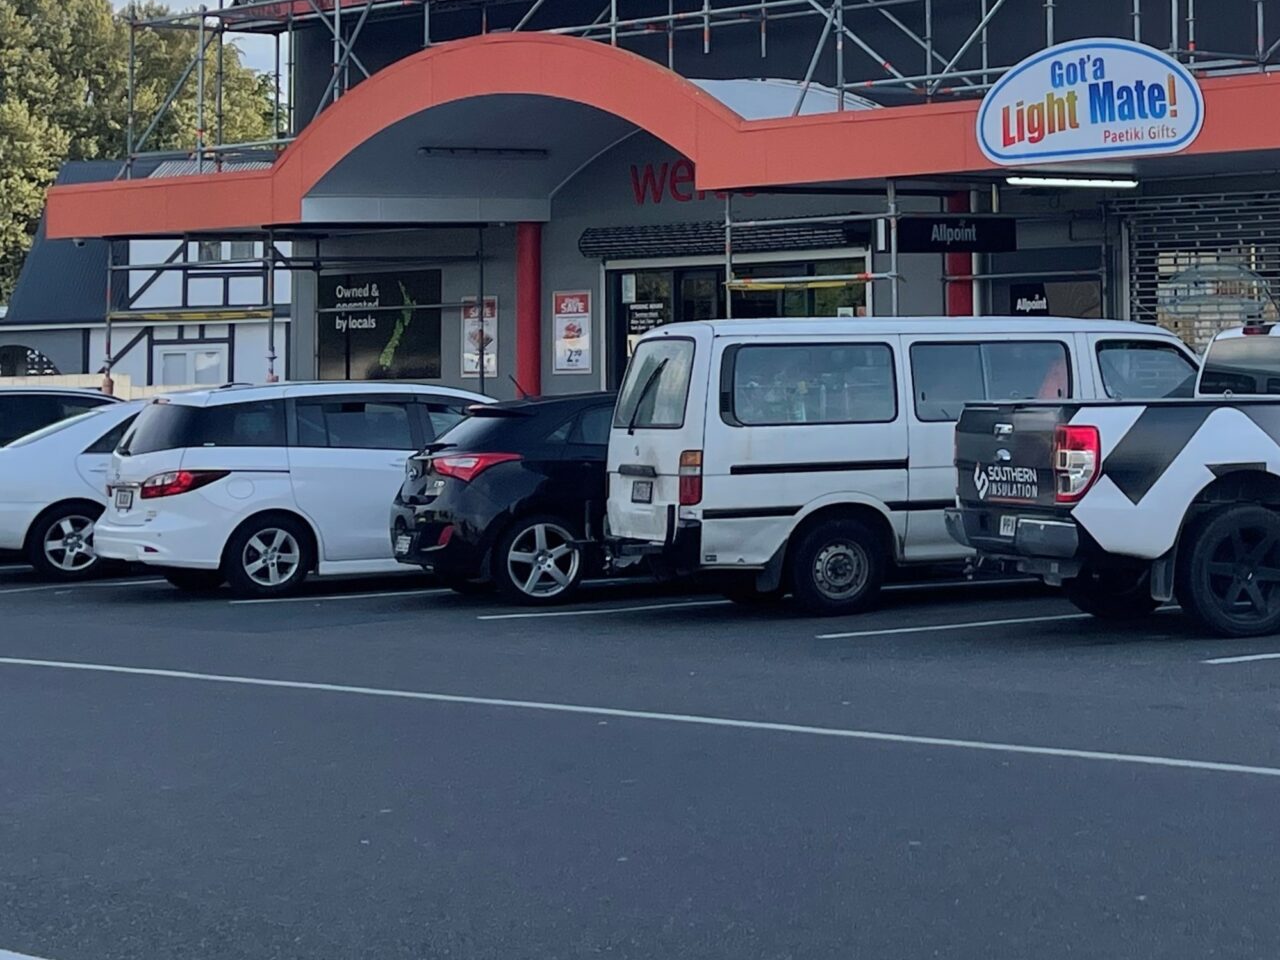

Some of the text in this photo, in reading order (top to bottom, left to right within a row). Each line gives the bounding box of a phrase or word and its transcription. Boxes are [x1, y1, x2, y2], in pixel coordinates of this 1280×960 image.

[1051, 54, 1105, 89] Got'a
[1002, 72, 1178, 148] Light Mate!
[1103, 124, 1177, 144] Paetiki Gifts
[931, 222, 976, 245] Allpoint
[335, 283, 380, 298] Owned &
[560, 301, 585, 314] SAVE
[1016, 296, 1047, 312] Allpoint
[335, 314, 376, 332] by locals
[987, 465, 1038, 483] SOUTHERN
[988, 482, 1039, 498] INSULATION
